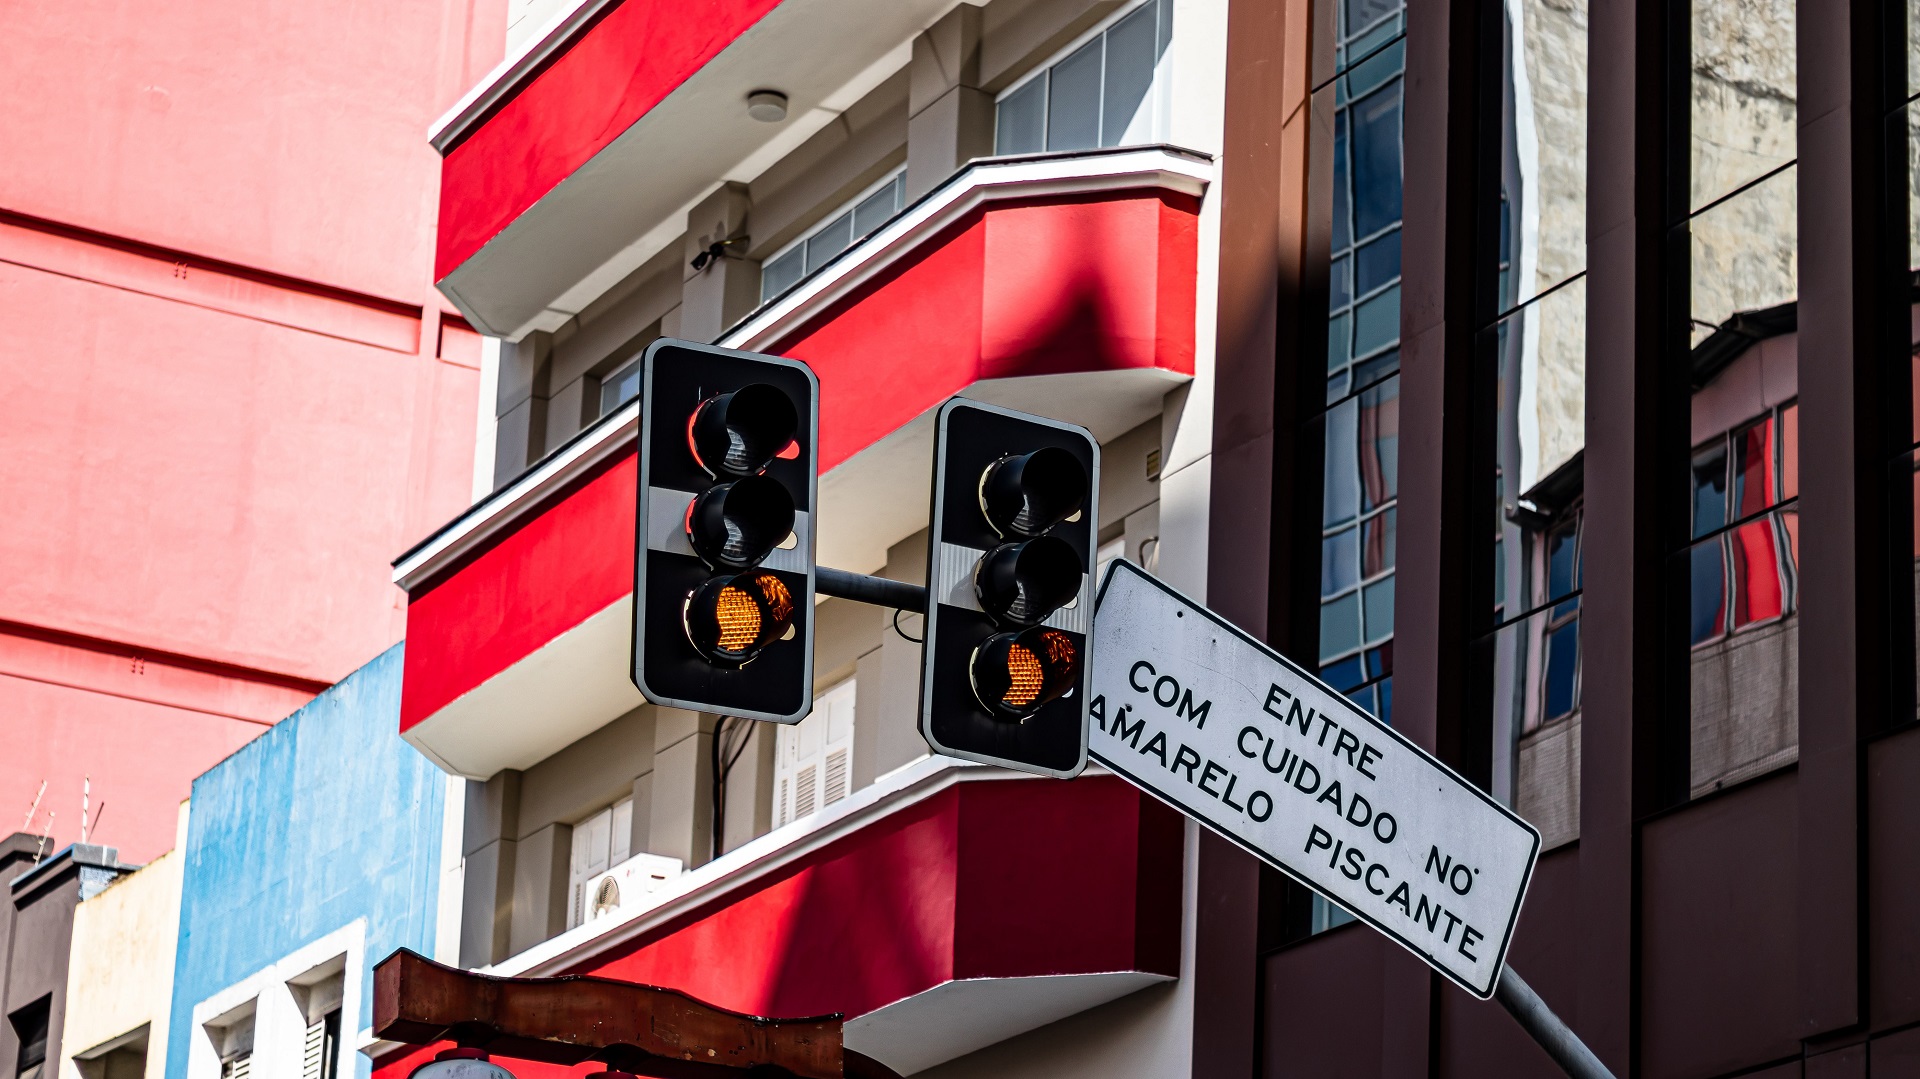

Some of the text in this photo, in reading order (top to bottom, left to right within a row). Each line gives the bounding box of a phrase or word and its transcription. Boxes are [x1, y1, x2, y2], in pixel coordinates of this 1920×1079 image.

[1089, 693, 1485, 964] AMARELO PISCANTE
[1128, 660, 1473, 896] COM CUIDADO NO
[1262, 682, 1384, 782] ENTRE
